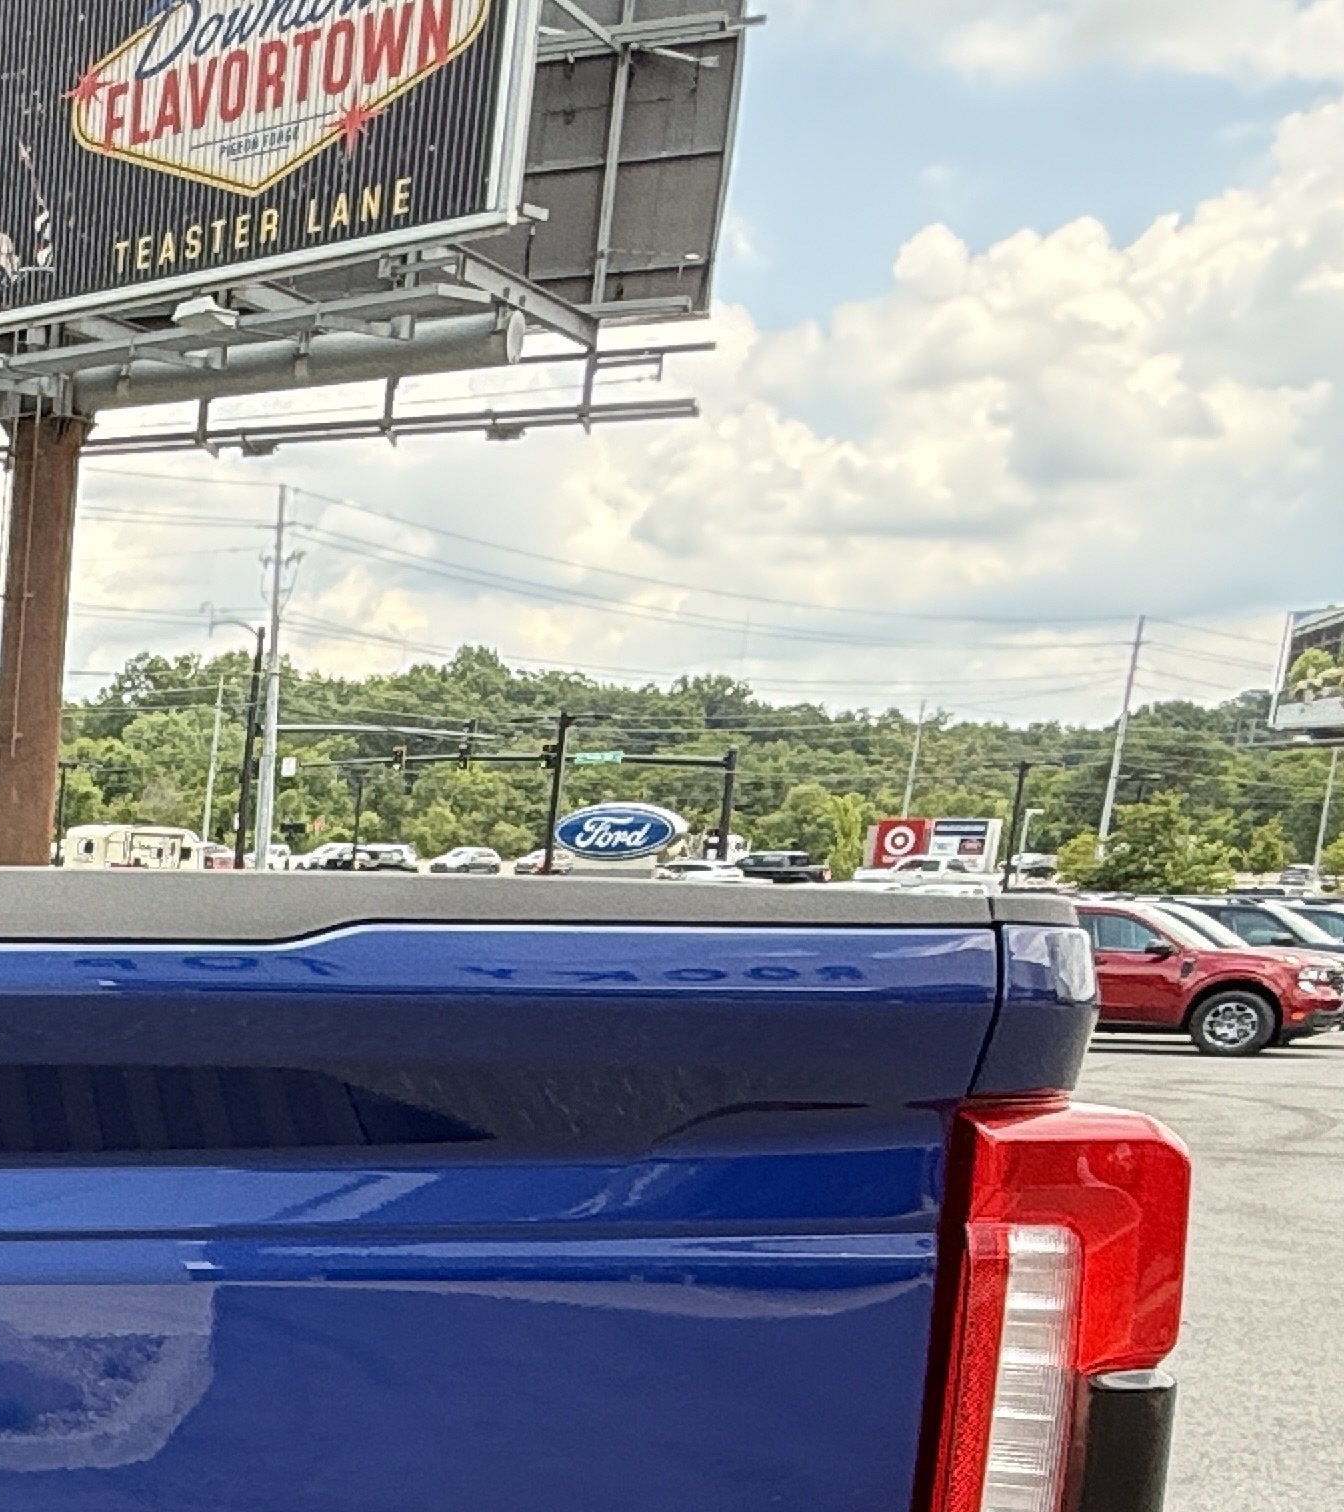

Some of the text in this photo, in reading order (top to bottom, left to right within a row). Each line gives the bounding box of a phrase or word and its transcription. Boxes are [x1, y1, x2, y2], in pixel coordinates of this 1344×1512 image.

[103, 1, 453, 151] FLAVORTOWN
[115, 177, 412, 275] TEASTER LANE
[574, 816, 652, 848] Ford
